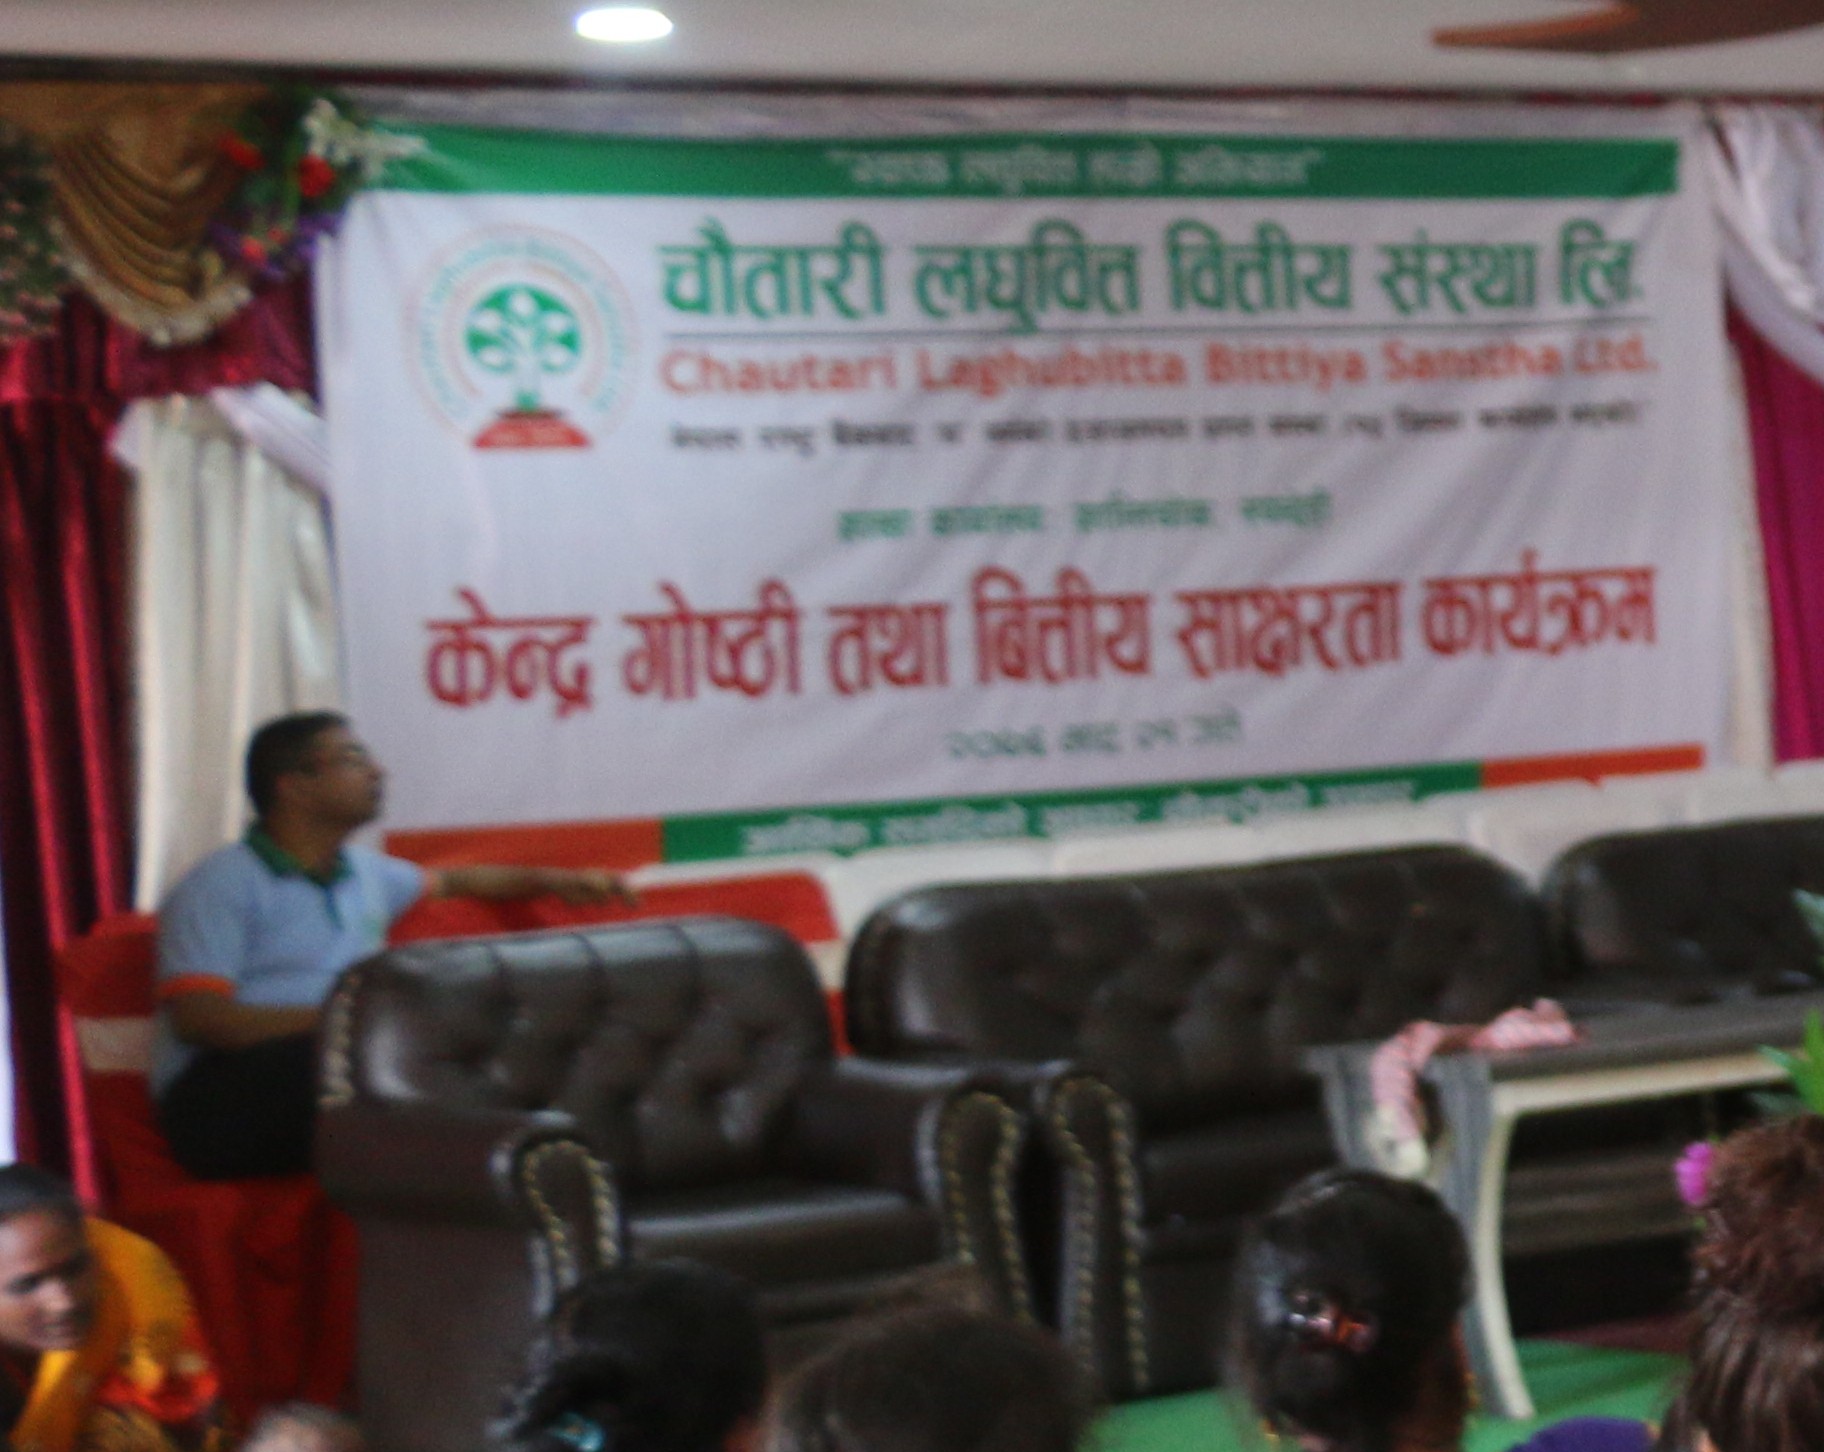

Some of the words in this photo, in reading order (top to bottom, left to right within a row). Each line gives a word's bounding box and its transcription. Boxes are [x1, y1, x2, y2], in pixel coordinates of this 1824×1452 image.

[657, 218, 886, 318] चौतारी
[1377, 228, 1537, 314] संस्था
[659, 350, 896, 394] Chautari
[916, 347, 1187, 398] Laghubitta
[1207, 341, 1368, 392] Bittiya
[1381, 337, 1564, 382] Sanstha
[425, 585, 595, 718] केन्द्र
[623, 577, 803, 699] गोष्ठी
[828, 602, 948, 695] तथा
[1175, 580, 1404, 680] साक्षरता
[1422, 547, 1656, 659] कार्यक्रम
